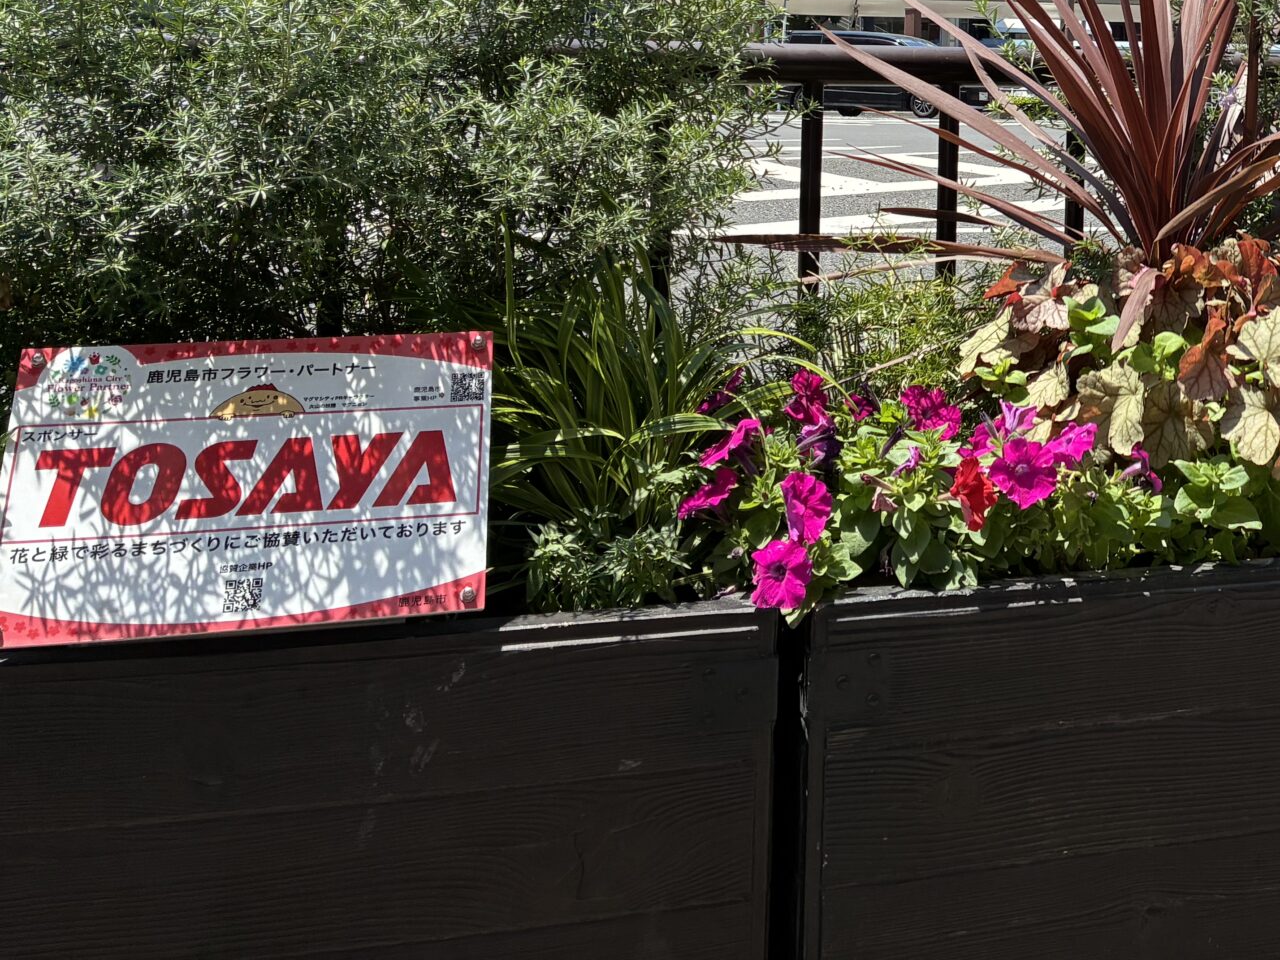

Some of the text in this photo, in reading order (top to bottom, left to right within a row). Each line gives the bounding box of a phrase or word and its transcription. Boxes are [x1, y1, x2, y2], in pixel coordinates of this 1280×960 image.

[146, 362, 377, 385] 鹿児島市フラワー・パートナー
[46, 382, 130, 393] Flower Partner
[23, 427, 98, 443] スポンサー
[35, 430, 457, 528] TOSAYA
[9, 519, 468, 566] 花と緑で彩るまちづくりにご協賛いただいております
